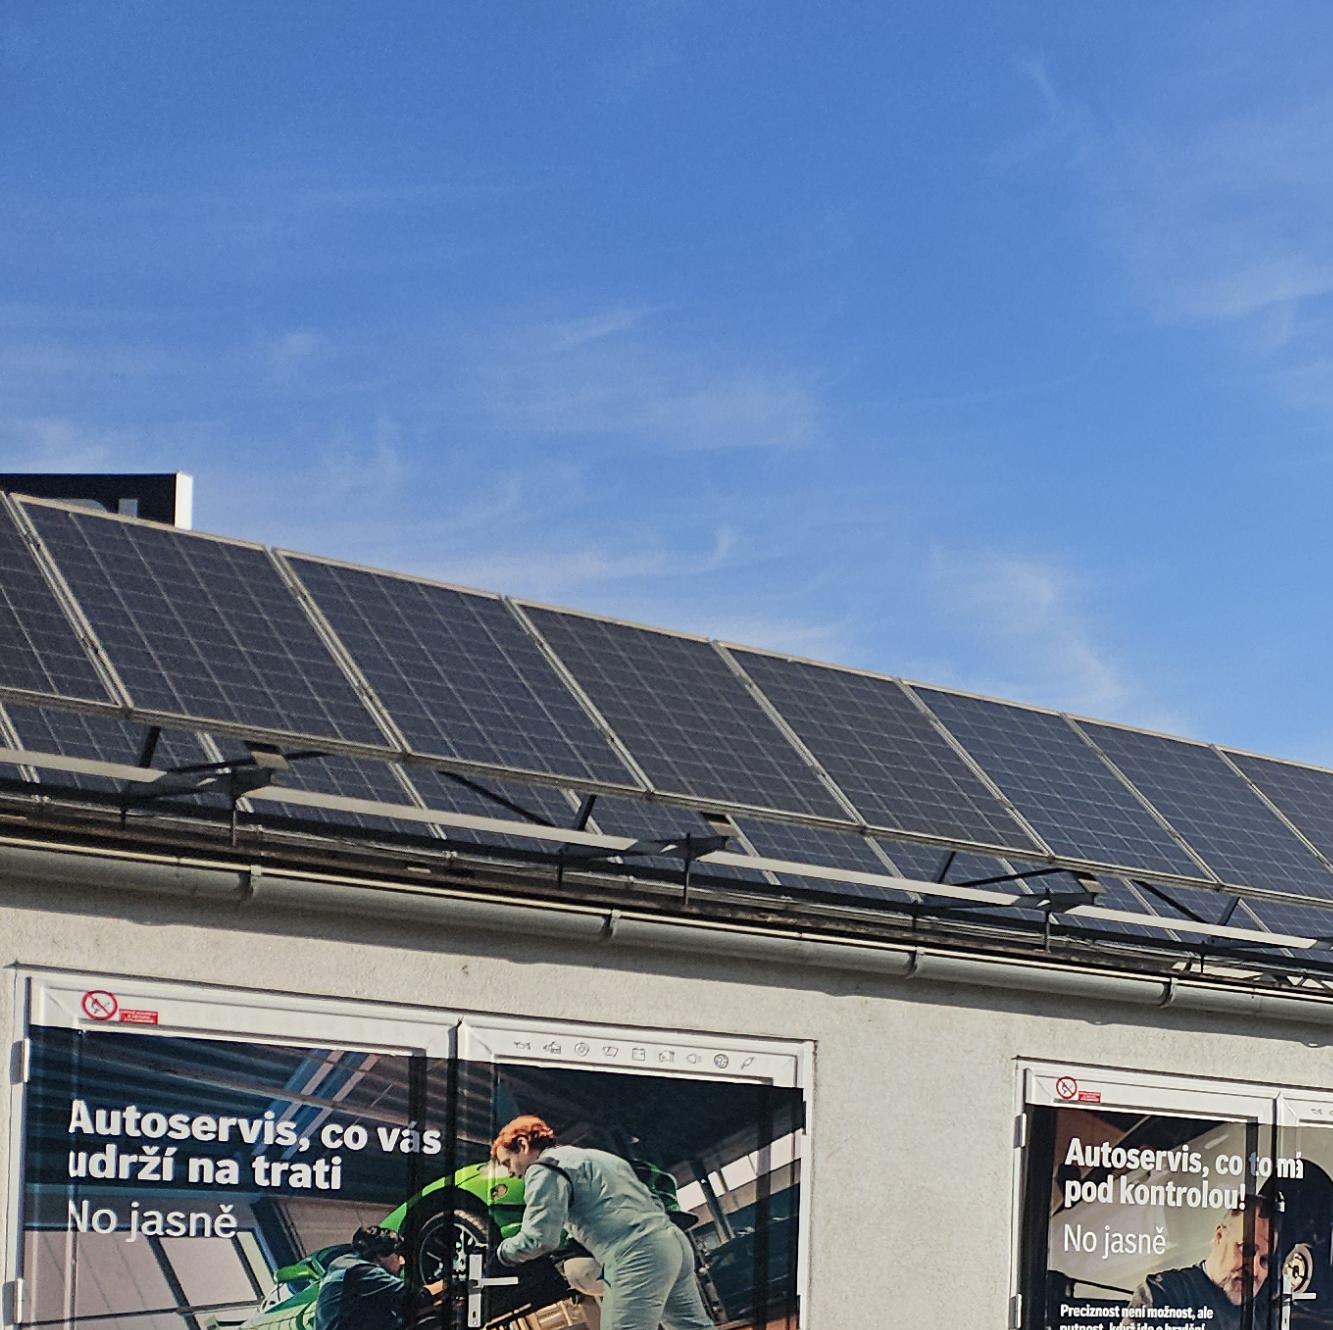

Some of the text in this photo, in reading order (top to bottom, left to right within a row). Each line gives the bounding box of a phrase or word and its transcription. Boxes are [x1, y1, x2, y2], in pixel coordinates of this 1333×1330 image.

[68, 1099, 442, 1154] Autoservis, co vás
[69, 1143, 342, 1190] udrží na trati
[1064, 1137, 1304, 1179] Autoservis, co to má
[1064, 1175, 1246, 1210] pod kontrolou!
[67, 1199, 238, 1243] No jasně
[1064, 1223, 1166, 1260] No jasně
[1121, 1304, 1147, 1318] není
[1147, 1305, 1195, 1321] možnost,
[1197, 1305, 1214, 1319] ale
